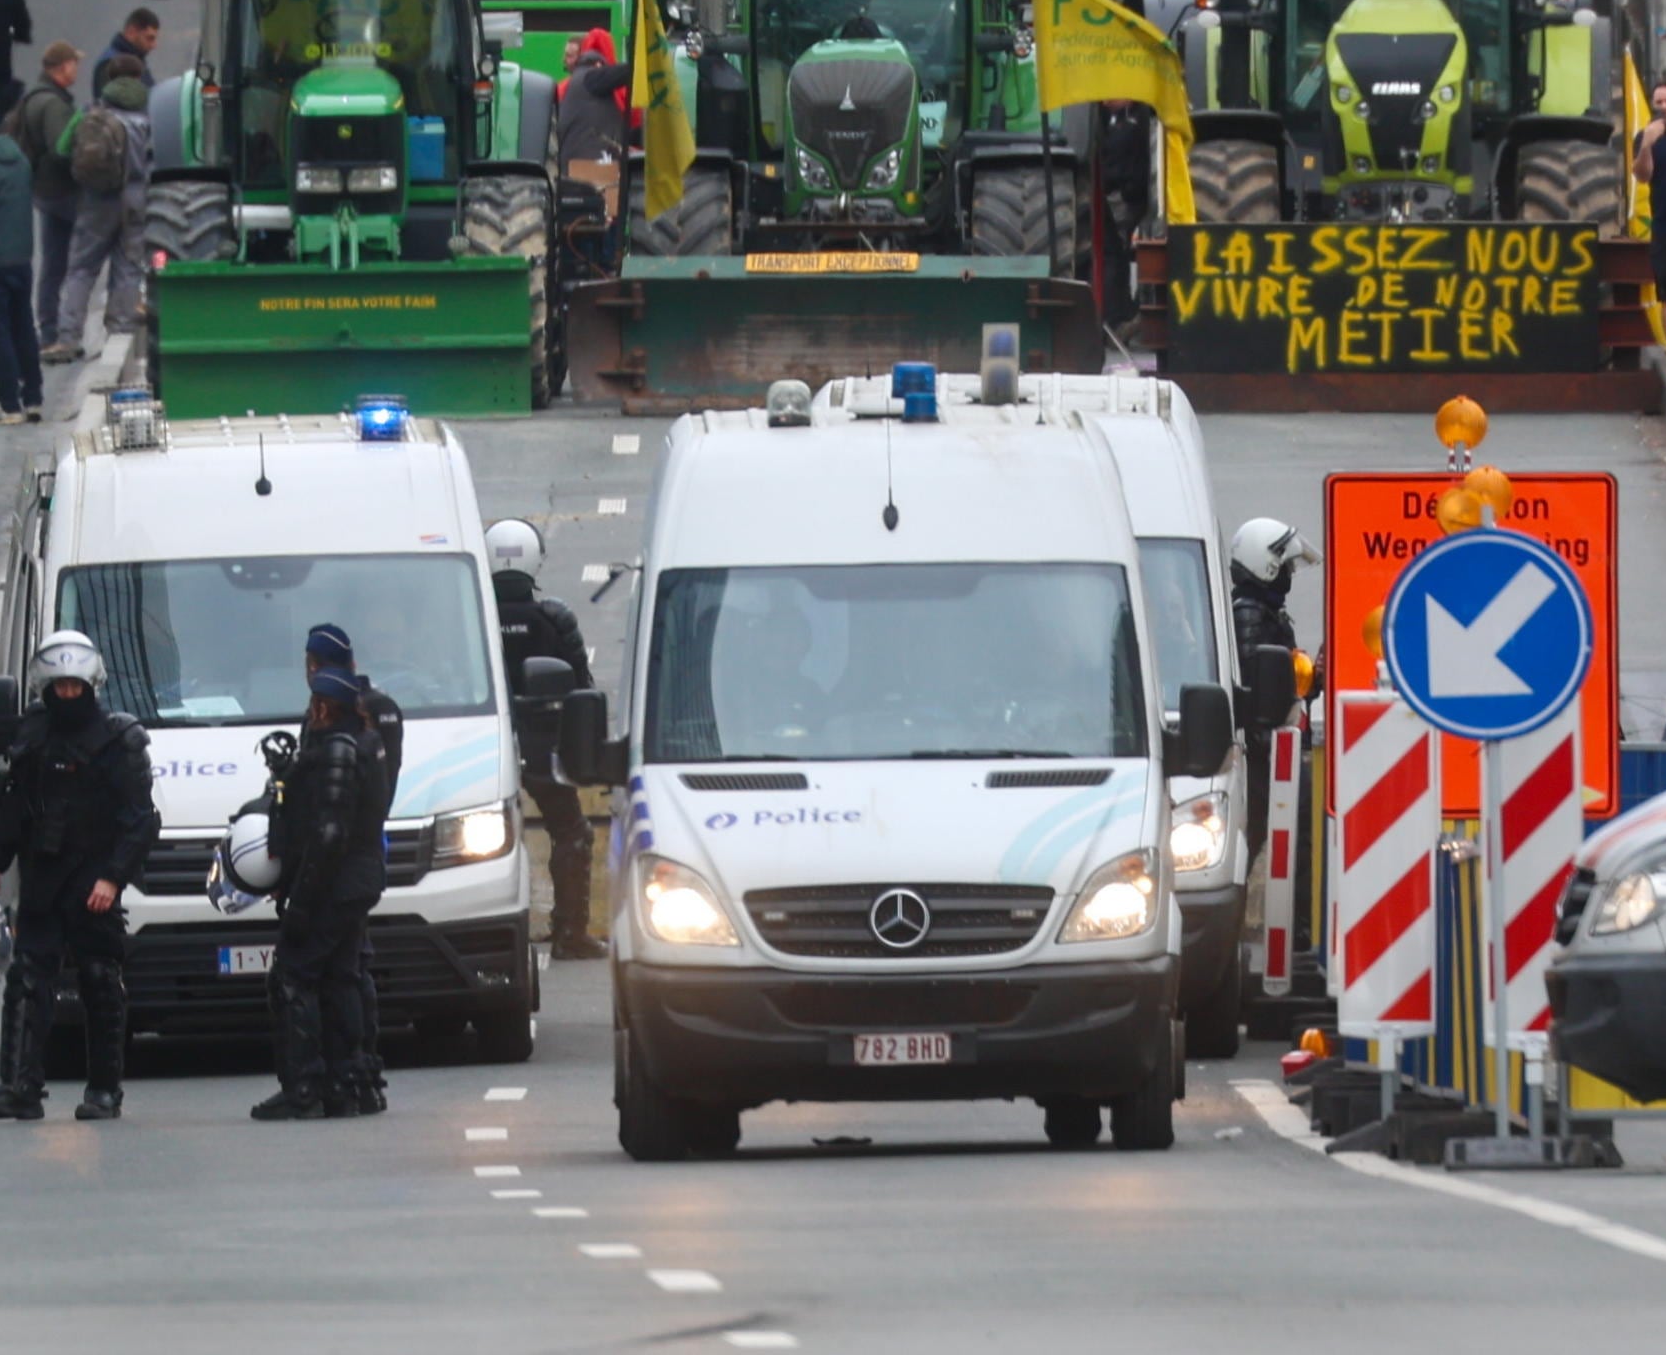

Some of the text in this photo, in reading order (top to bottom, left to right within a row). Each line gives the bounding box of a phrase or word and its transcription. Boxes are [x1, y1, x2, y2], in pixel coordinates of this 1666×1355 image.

[1371, 81, 1422, 95] CLAAS
[1193, 227, 1597, 276] LAISSEZ NOUS
[752, 253, 915, 270] TRANSPORT EXCEPTIONNEL
[261, 299, 301, 311] NOTRE
[328, 297, 359, 309] SERA
[363, 296, 401, 309] VOTRE
[1171, 273, 1582, 324] VIVRE DE NOTRE
[151, 760, 238, 778] olice
[753, 807, 862, 826] Police
[858, 1037, 898, 1060] 782
